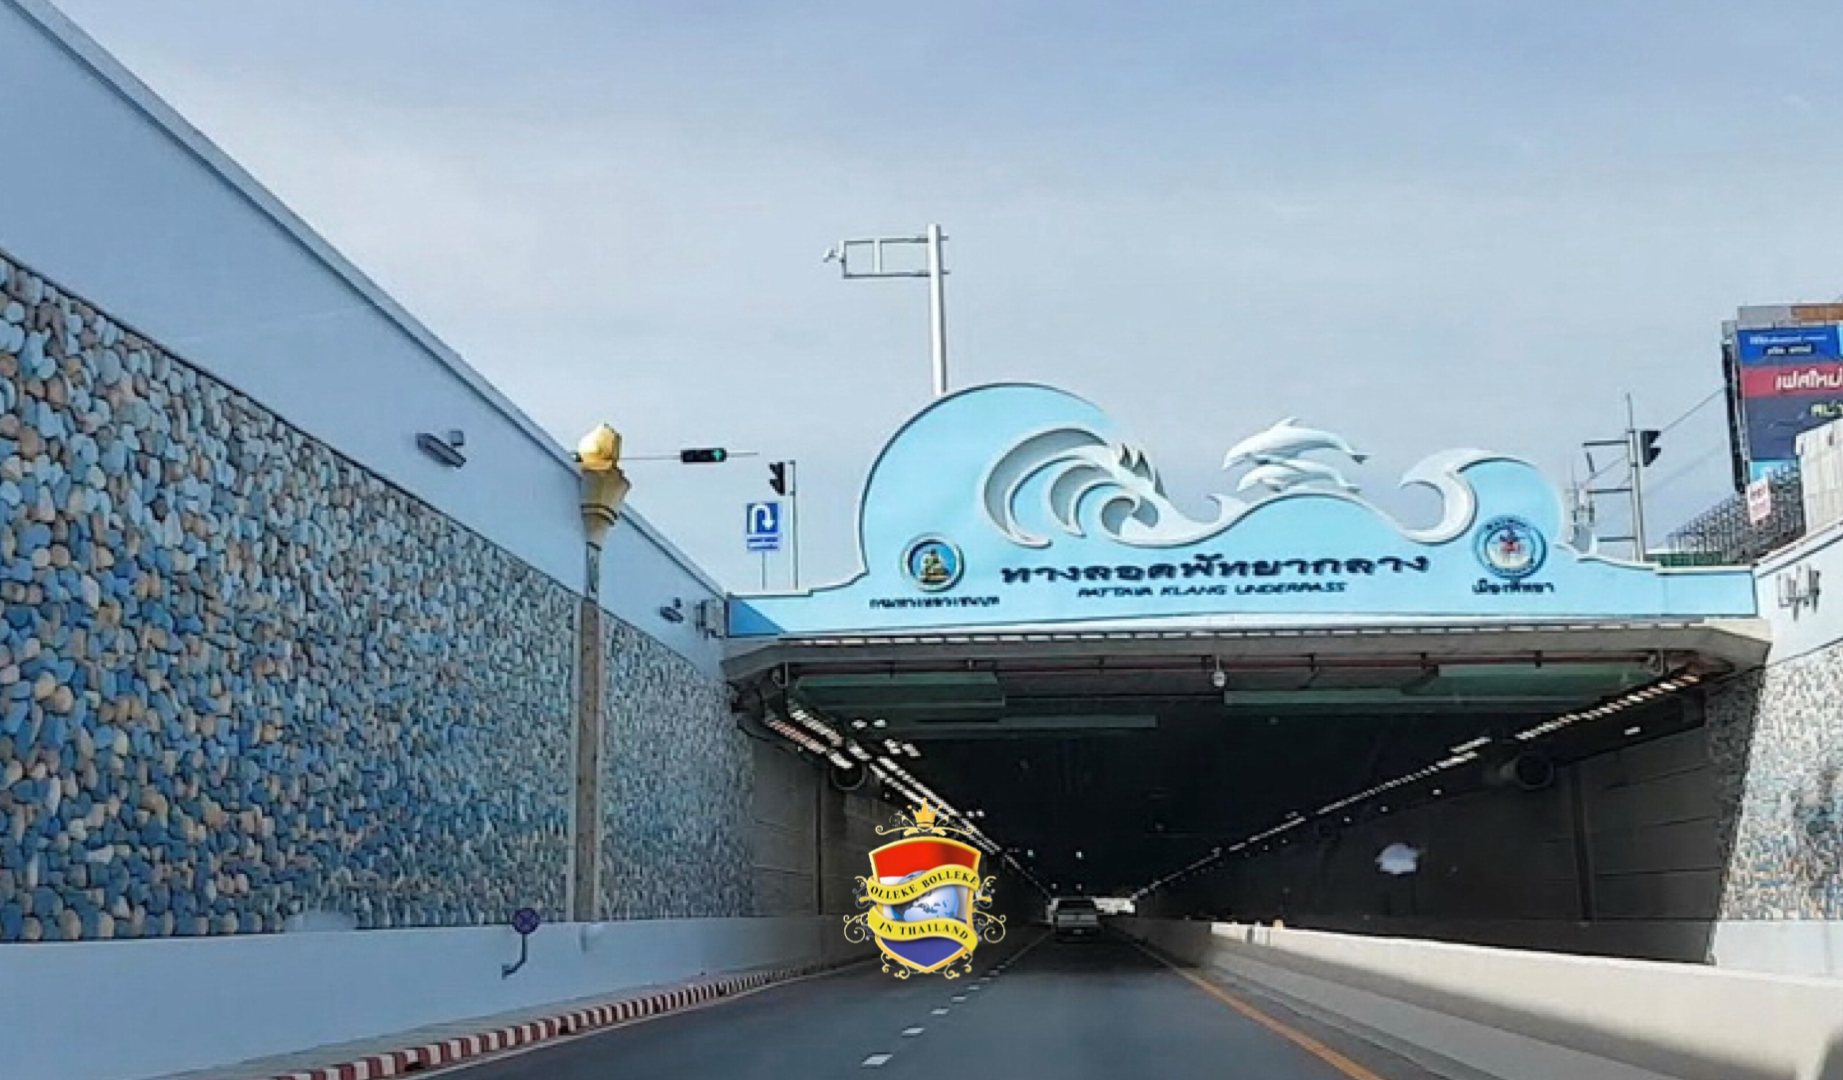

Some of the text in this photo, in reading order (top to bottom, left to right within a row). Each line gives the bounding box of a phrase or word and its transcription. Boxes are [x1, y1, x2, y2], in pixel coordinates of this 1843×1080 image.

[1000, 553, 1430, 584] ทางลอดพัทยากลาง
[1076, 582, 1347, 598] PATTAYA KLANG UNDERPASS
